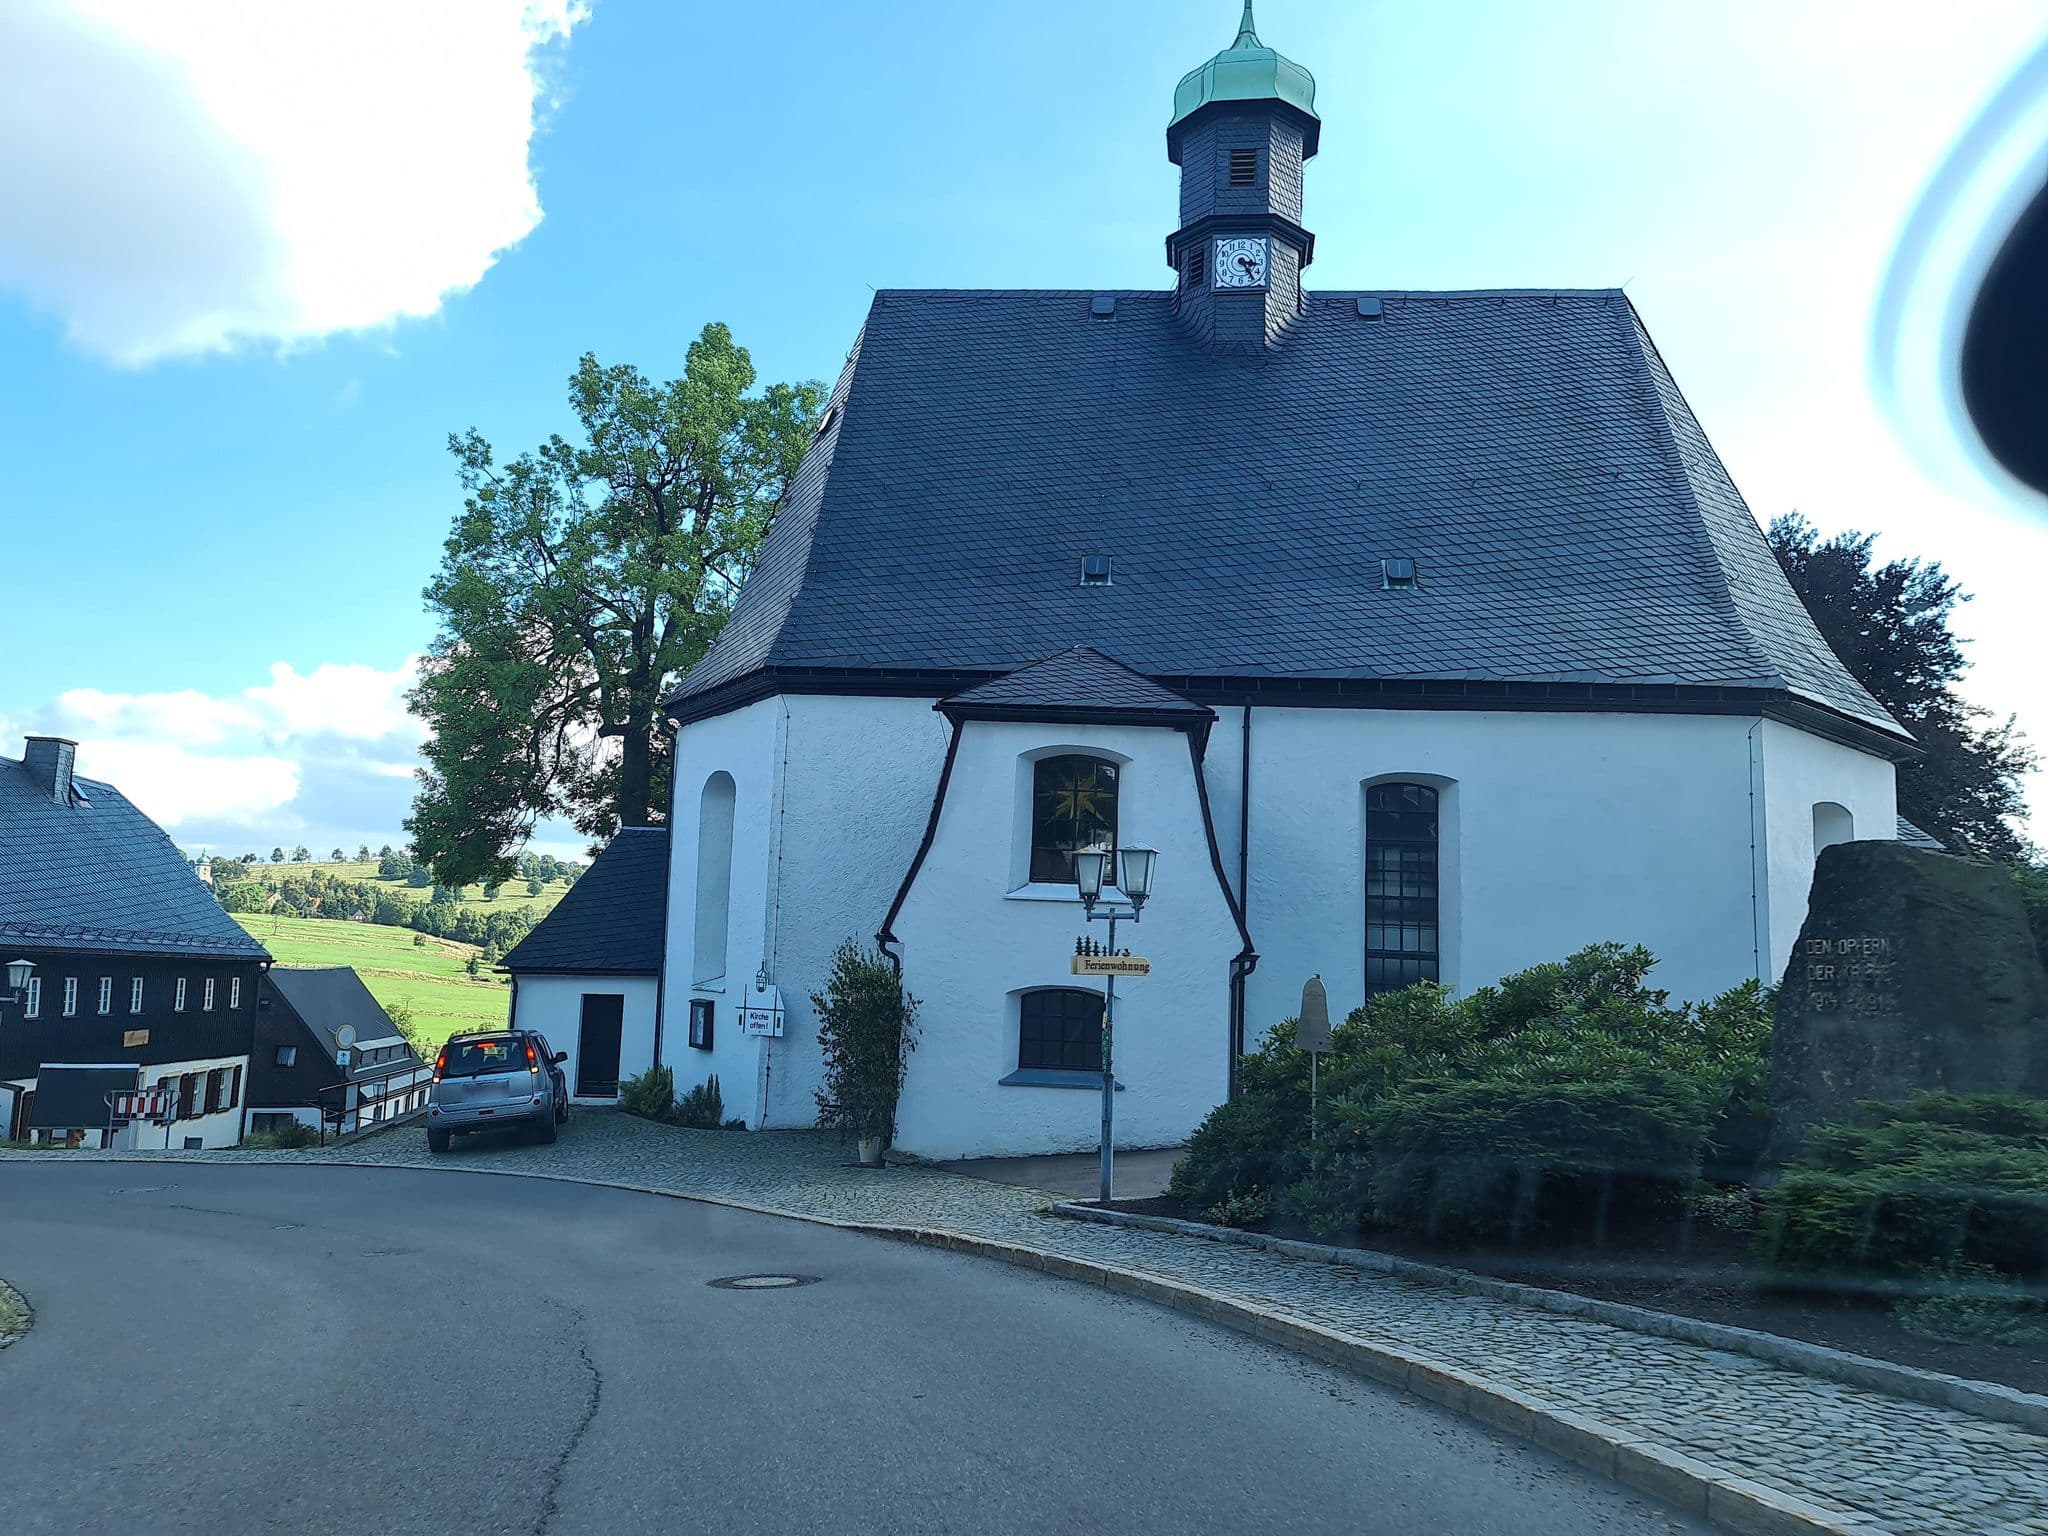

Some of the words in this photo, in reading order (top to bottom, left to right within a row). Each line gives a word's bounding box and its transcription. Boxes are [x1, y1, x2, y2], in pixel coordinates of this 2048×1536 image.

[1238, 276, 1244, 284] 6
[1805, 939, 1832, 954] DEN
[1084, 959, 1151, 973] Ferienwohnung
[1806, 964, 1835, 980] DER
[750, 1012, 769, 1020] Kirche
